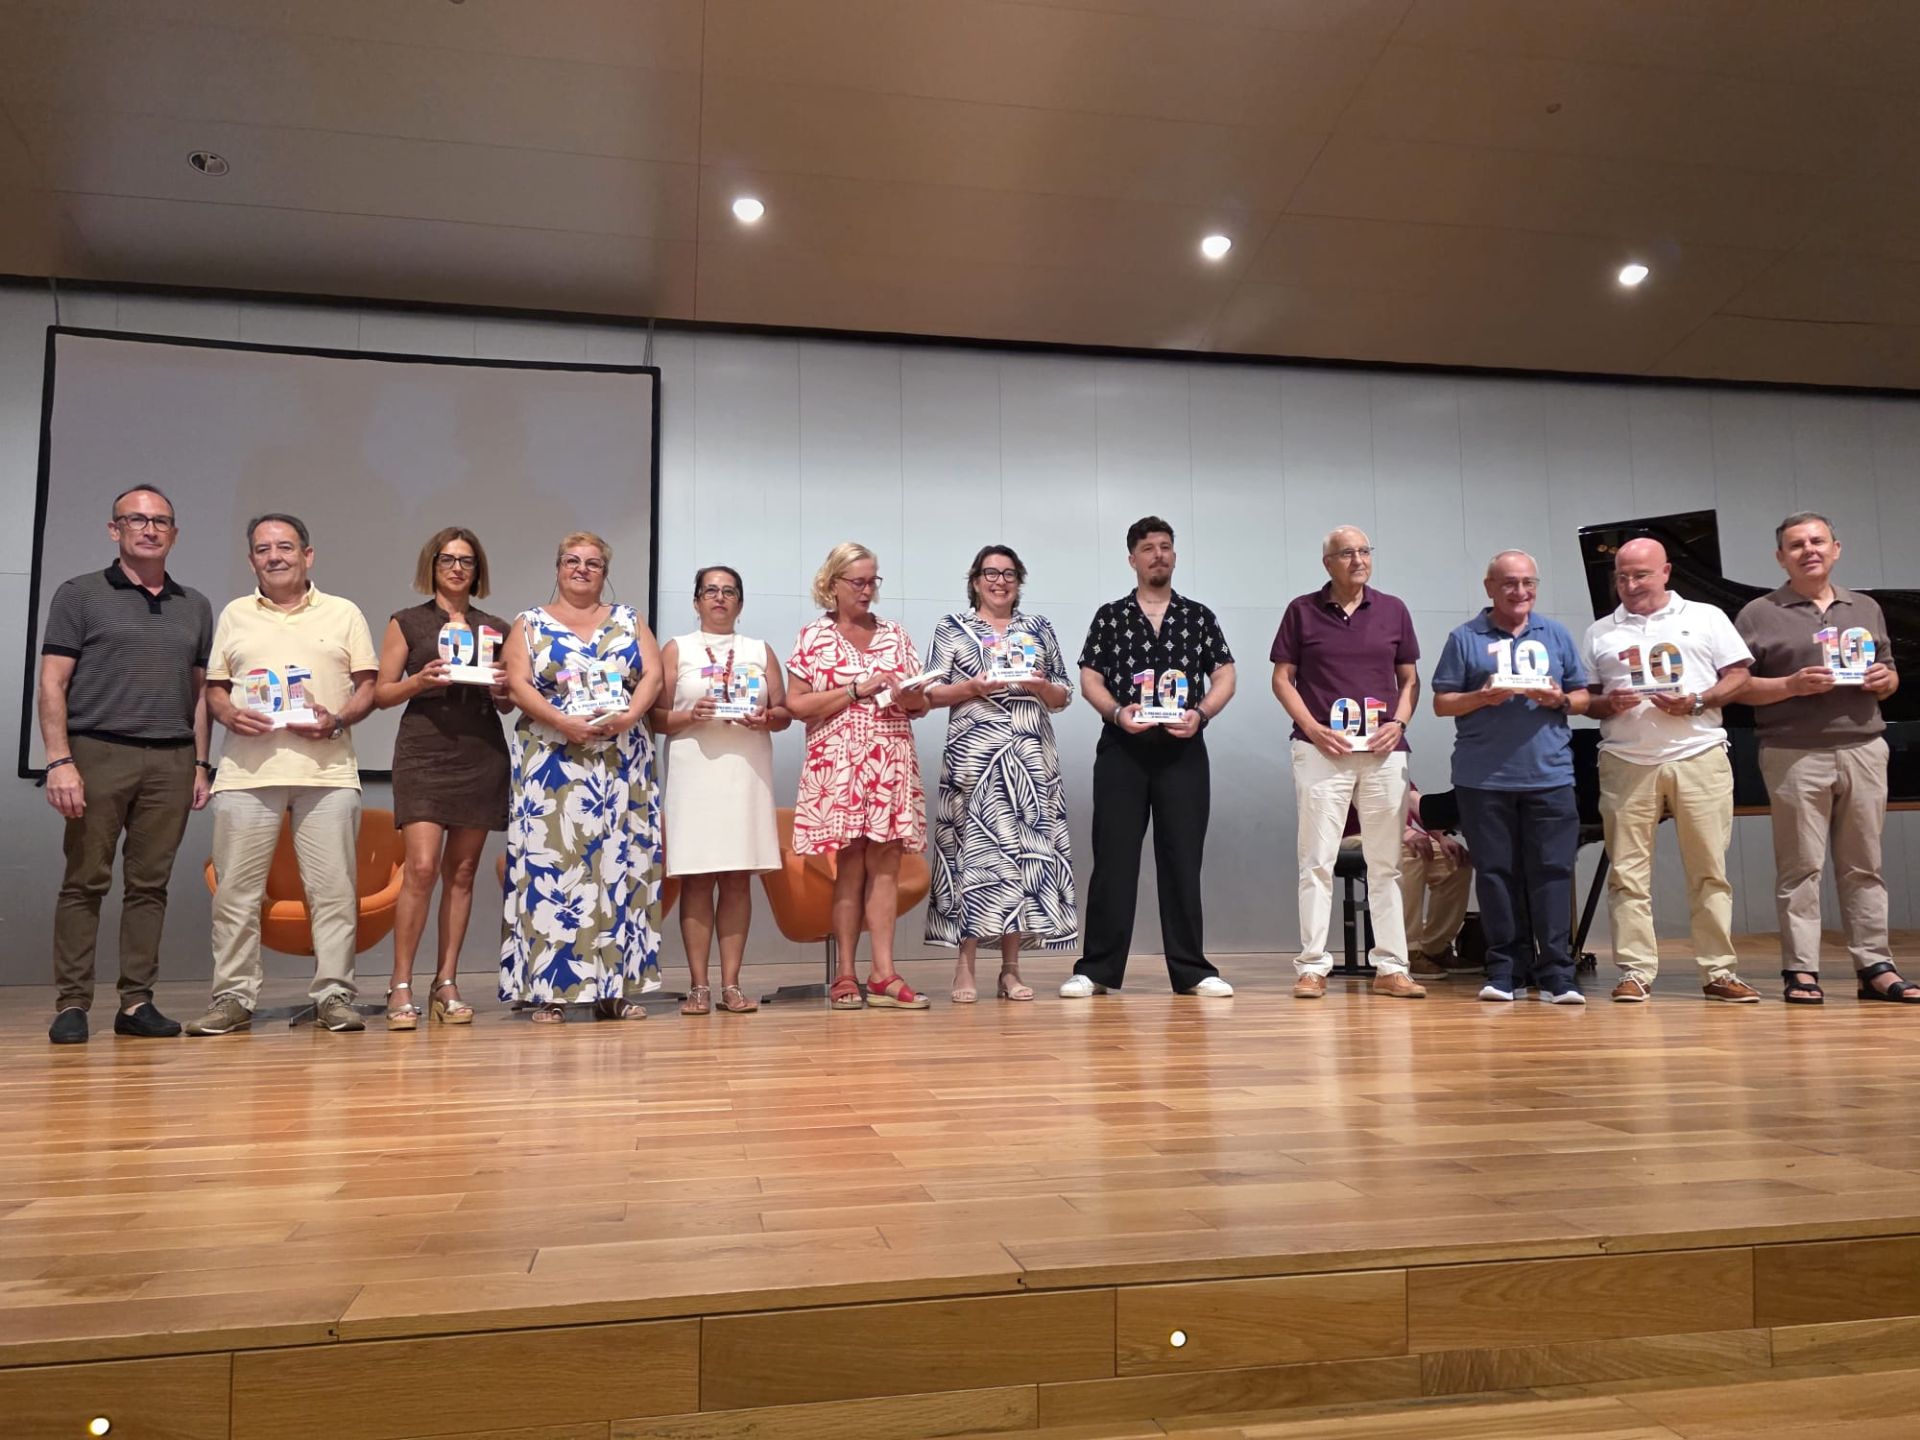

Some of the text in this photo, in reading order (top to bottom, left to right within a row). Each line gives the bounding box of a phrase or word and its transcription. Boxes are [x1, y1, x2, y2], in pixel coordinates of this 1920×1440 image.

[1487, 638, 1549, 675] 10
[1618, 643, 1684, 686] 10
[1813, 626, 1875, 668] 10
[1133, 669, 1188, 708] 10
